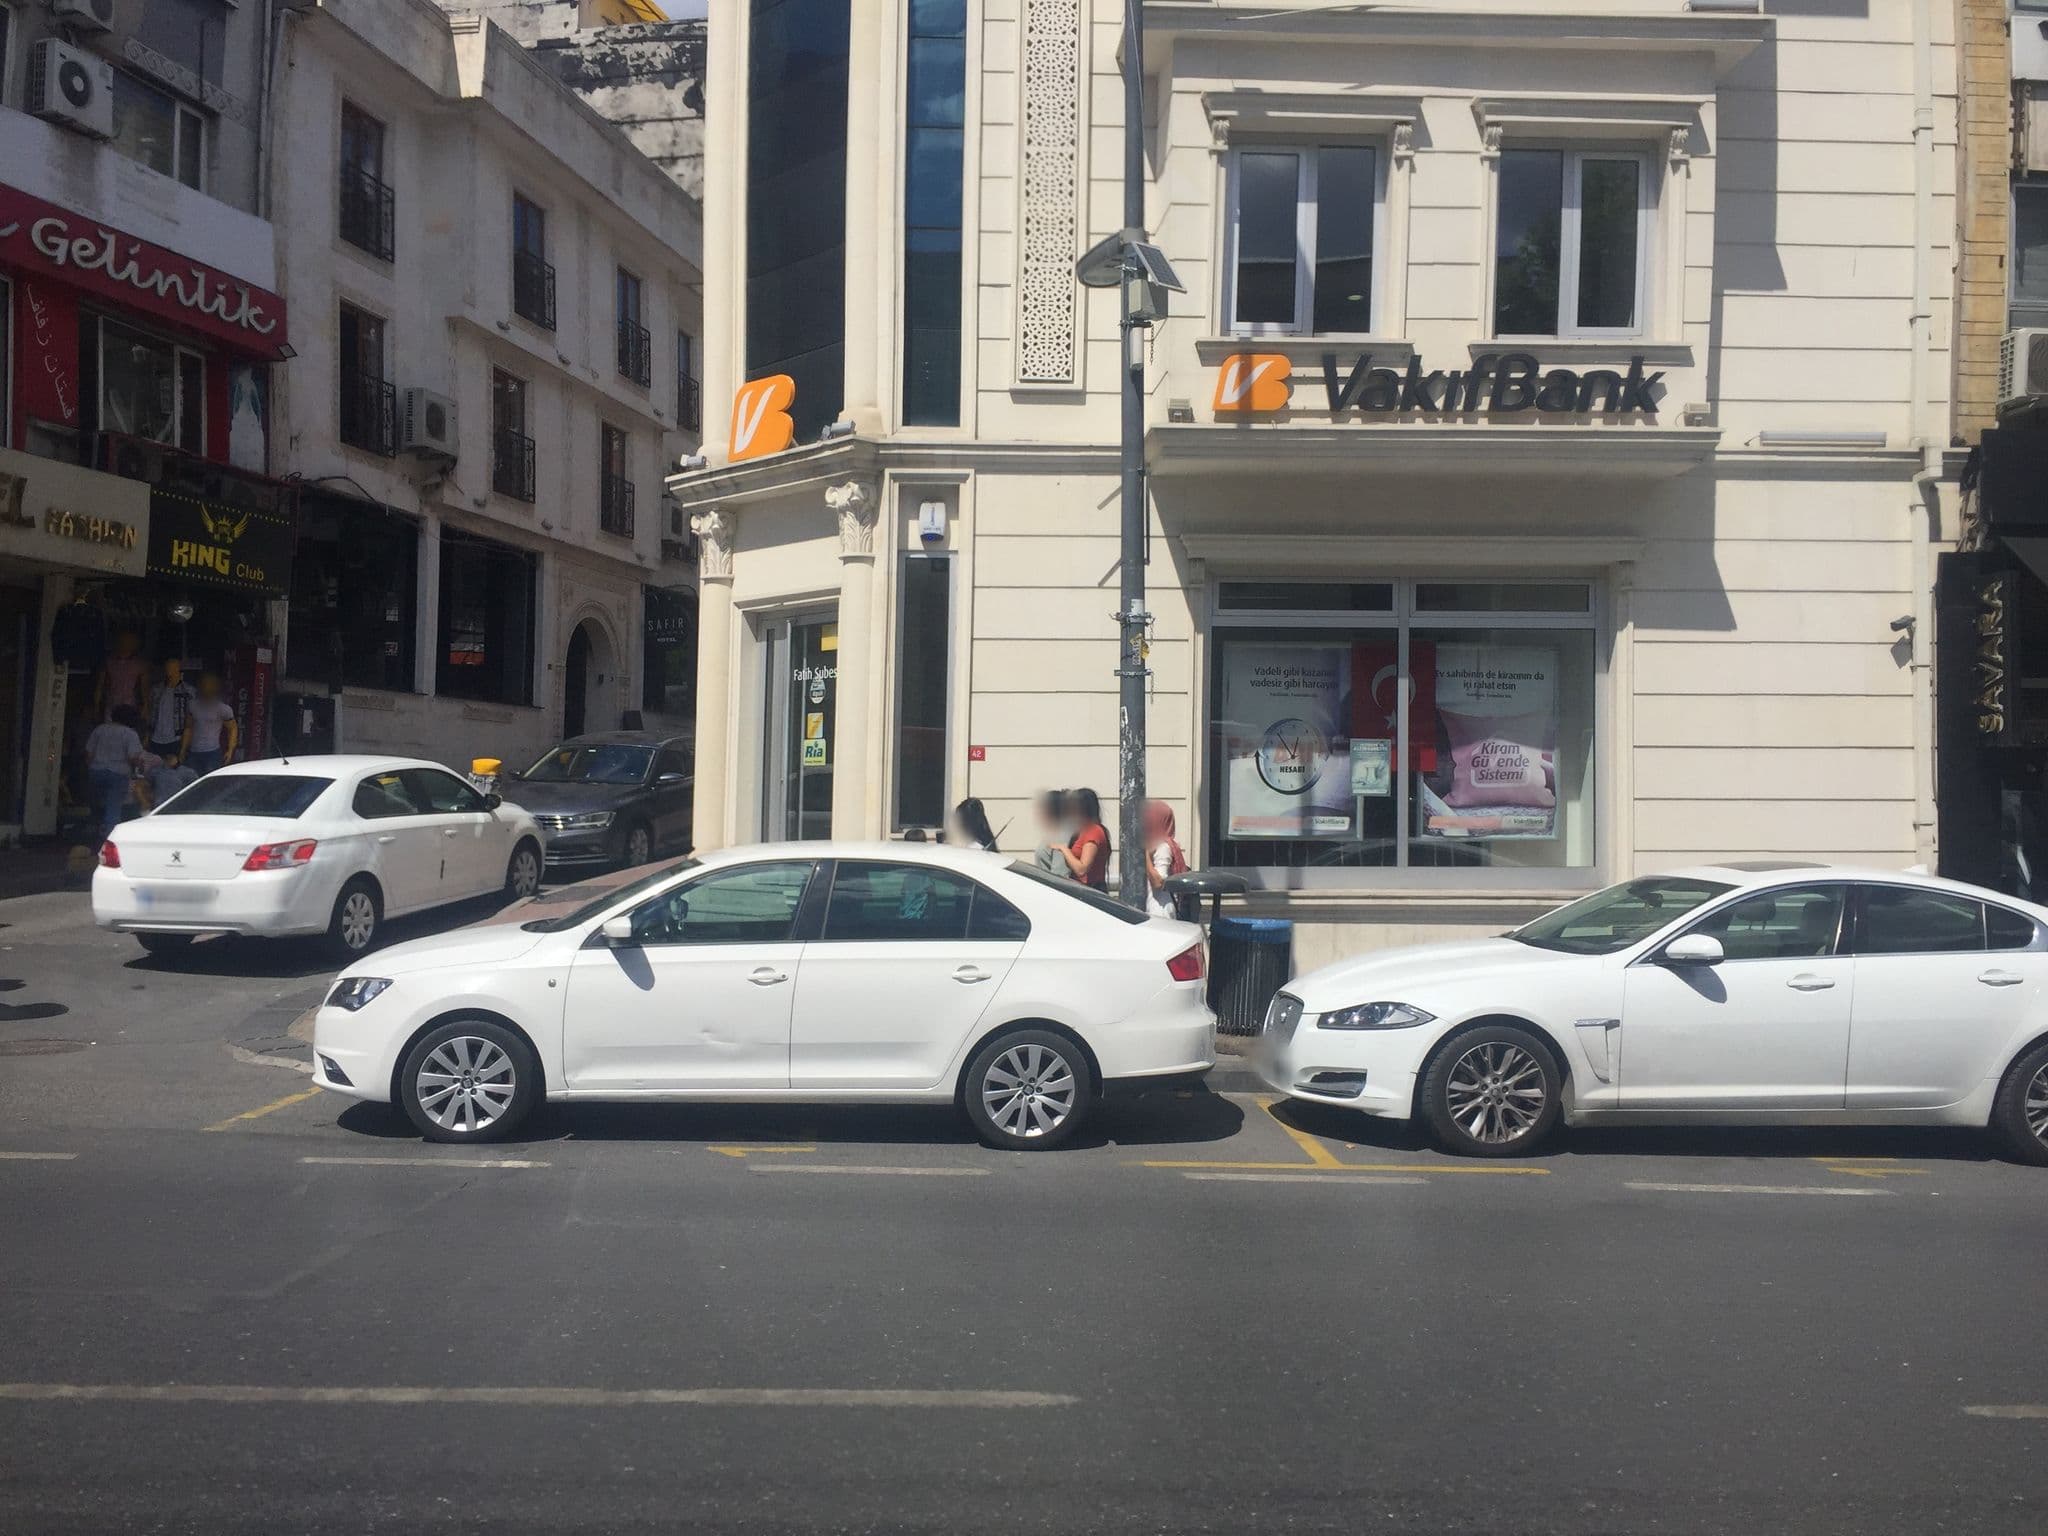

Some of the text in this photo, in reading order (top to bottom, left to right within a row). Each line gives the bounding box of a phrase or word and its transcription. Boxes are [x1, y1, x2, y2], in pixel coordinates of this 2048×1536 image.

[31, 217, 277, 334] Gelinlik
[1323, 353, 1667, 415] VakıfBank
[171, 539, 265, 582] KING Club
[648, 617, 685, 631] SAFIR
[793, 668, 813, 681] Fatih
[1283, 666, 1299, 678] gibi
[1485, 670, 1496, 680] de
[1534, 671, 1545, 681] da
[1250, 678, 1282, 688] vadesiz
[1284, 678, 1300, 690] gibi
[1474, 679, 1495, 690] rahat
[1496, 681, 1517, 691] etsin
[804, 744, 823, 759] Ria
[971, 749, 982, 759] 42
[1481, 742, 1520, 755] Kiram
[1478, 768, 1525, 781] Sistemi
